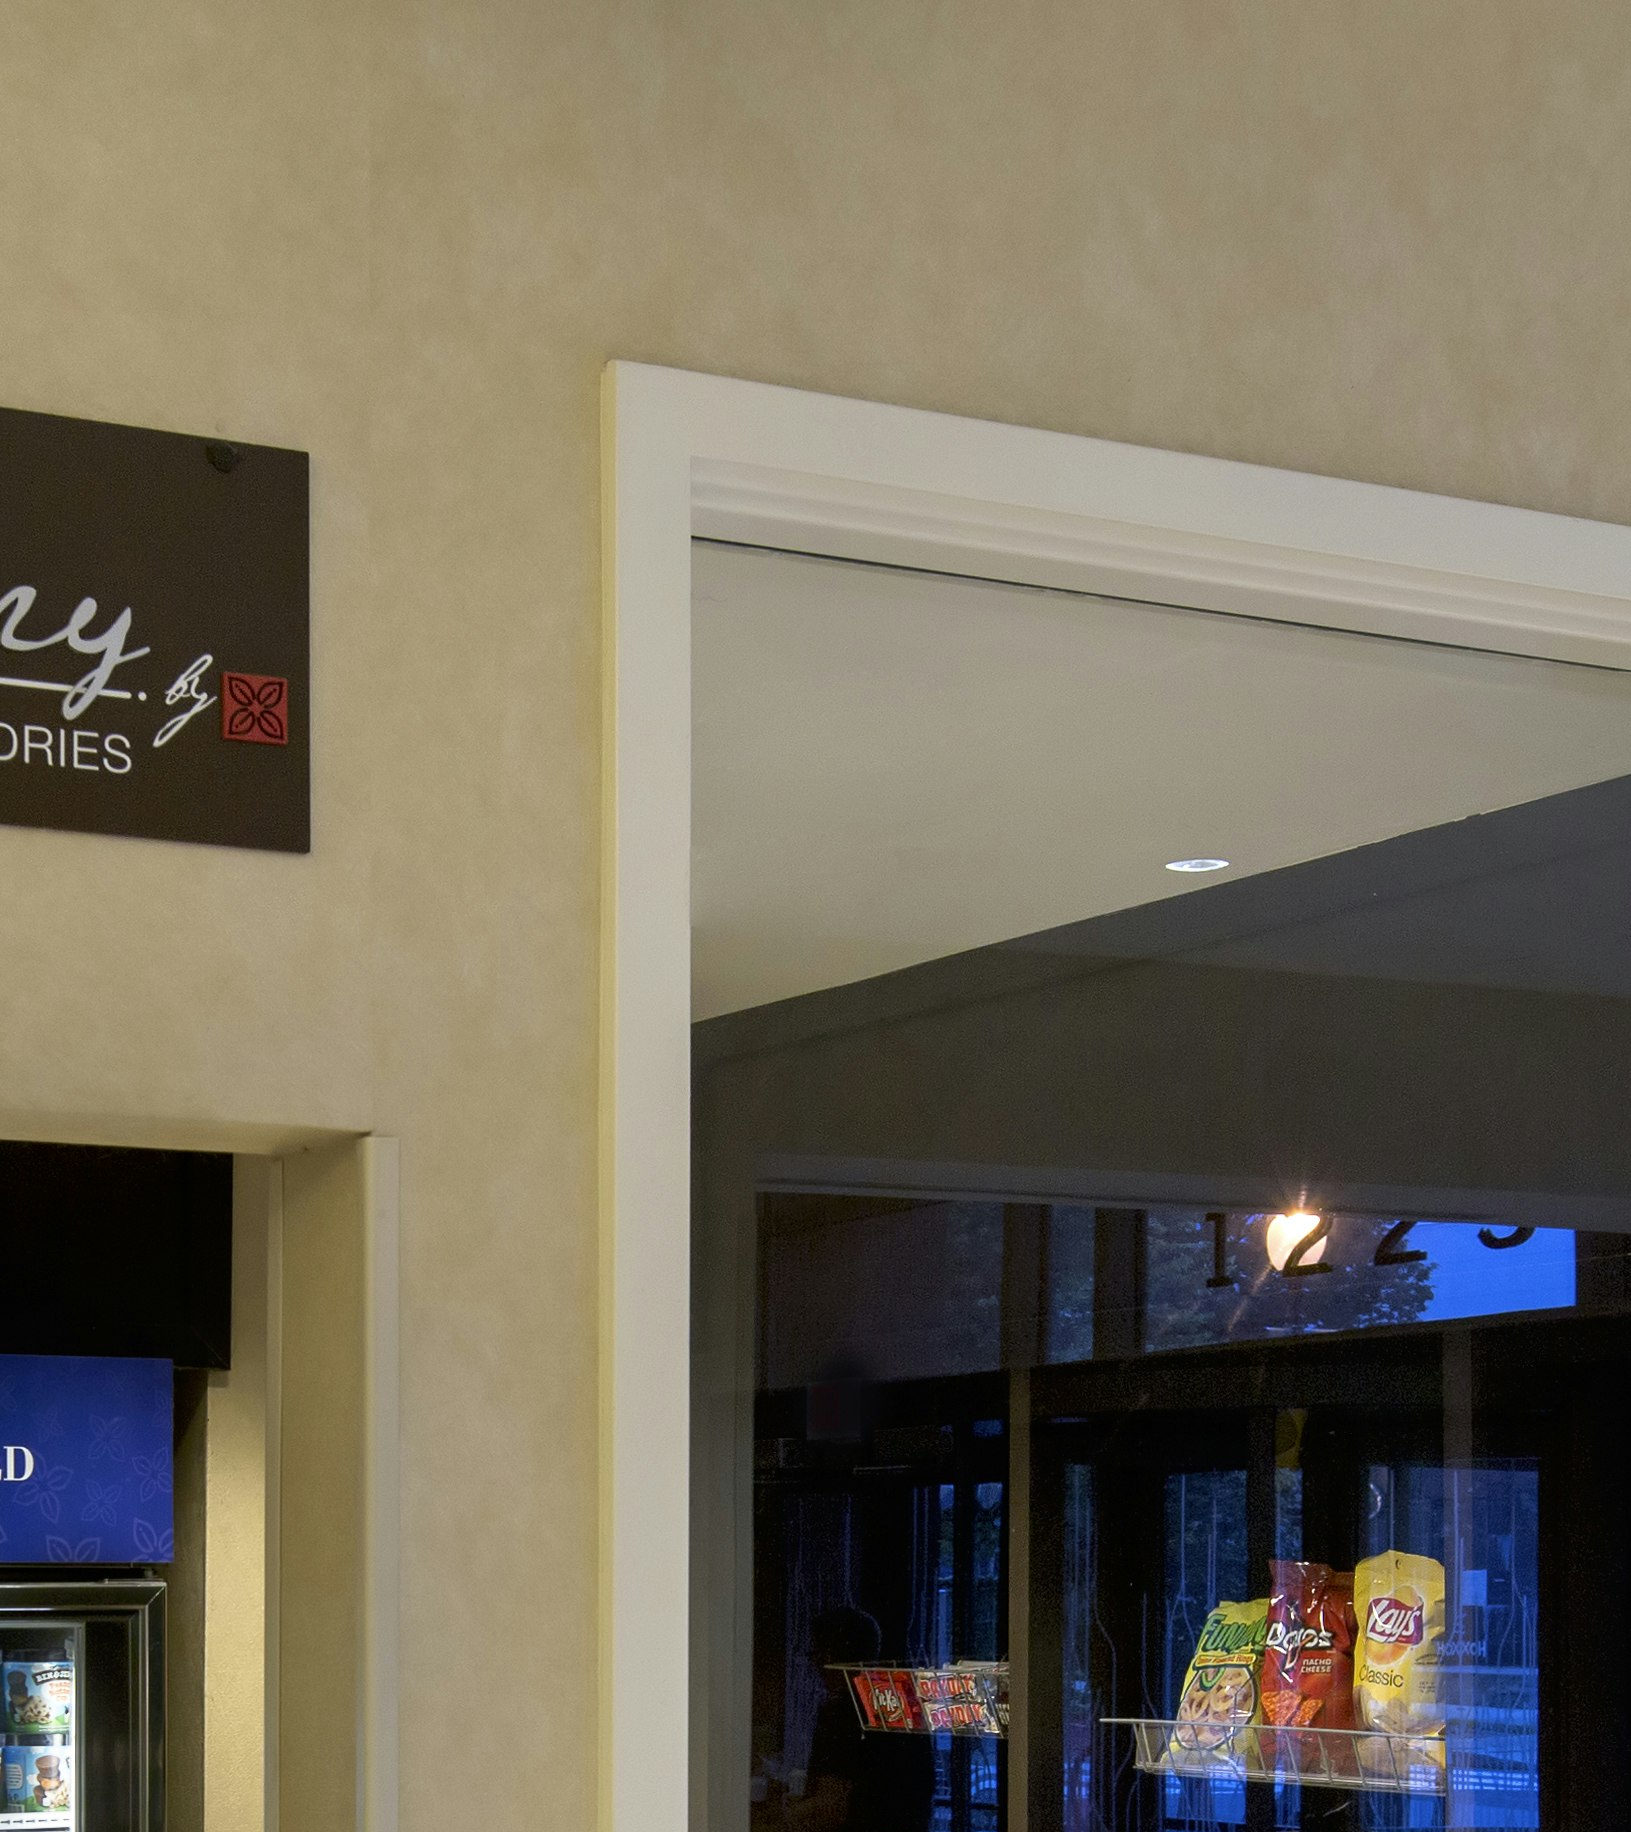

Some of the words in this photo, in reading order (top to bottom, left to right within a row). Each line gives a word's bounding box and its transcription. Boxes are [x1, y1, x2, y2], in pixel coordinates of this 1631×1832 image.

[154, 653, 220, 748] by
[1368, 1599, 1421, 1644] Lay's
[1359, 1663, 1404, 1689] Classic
